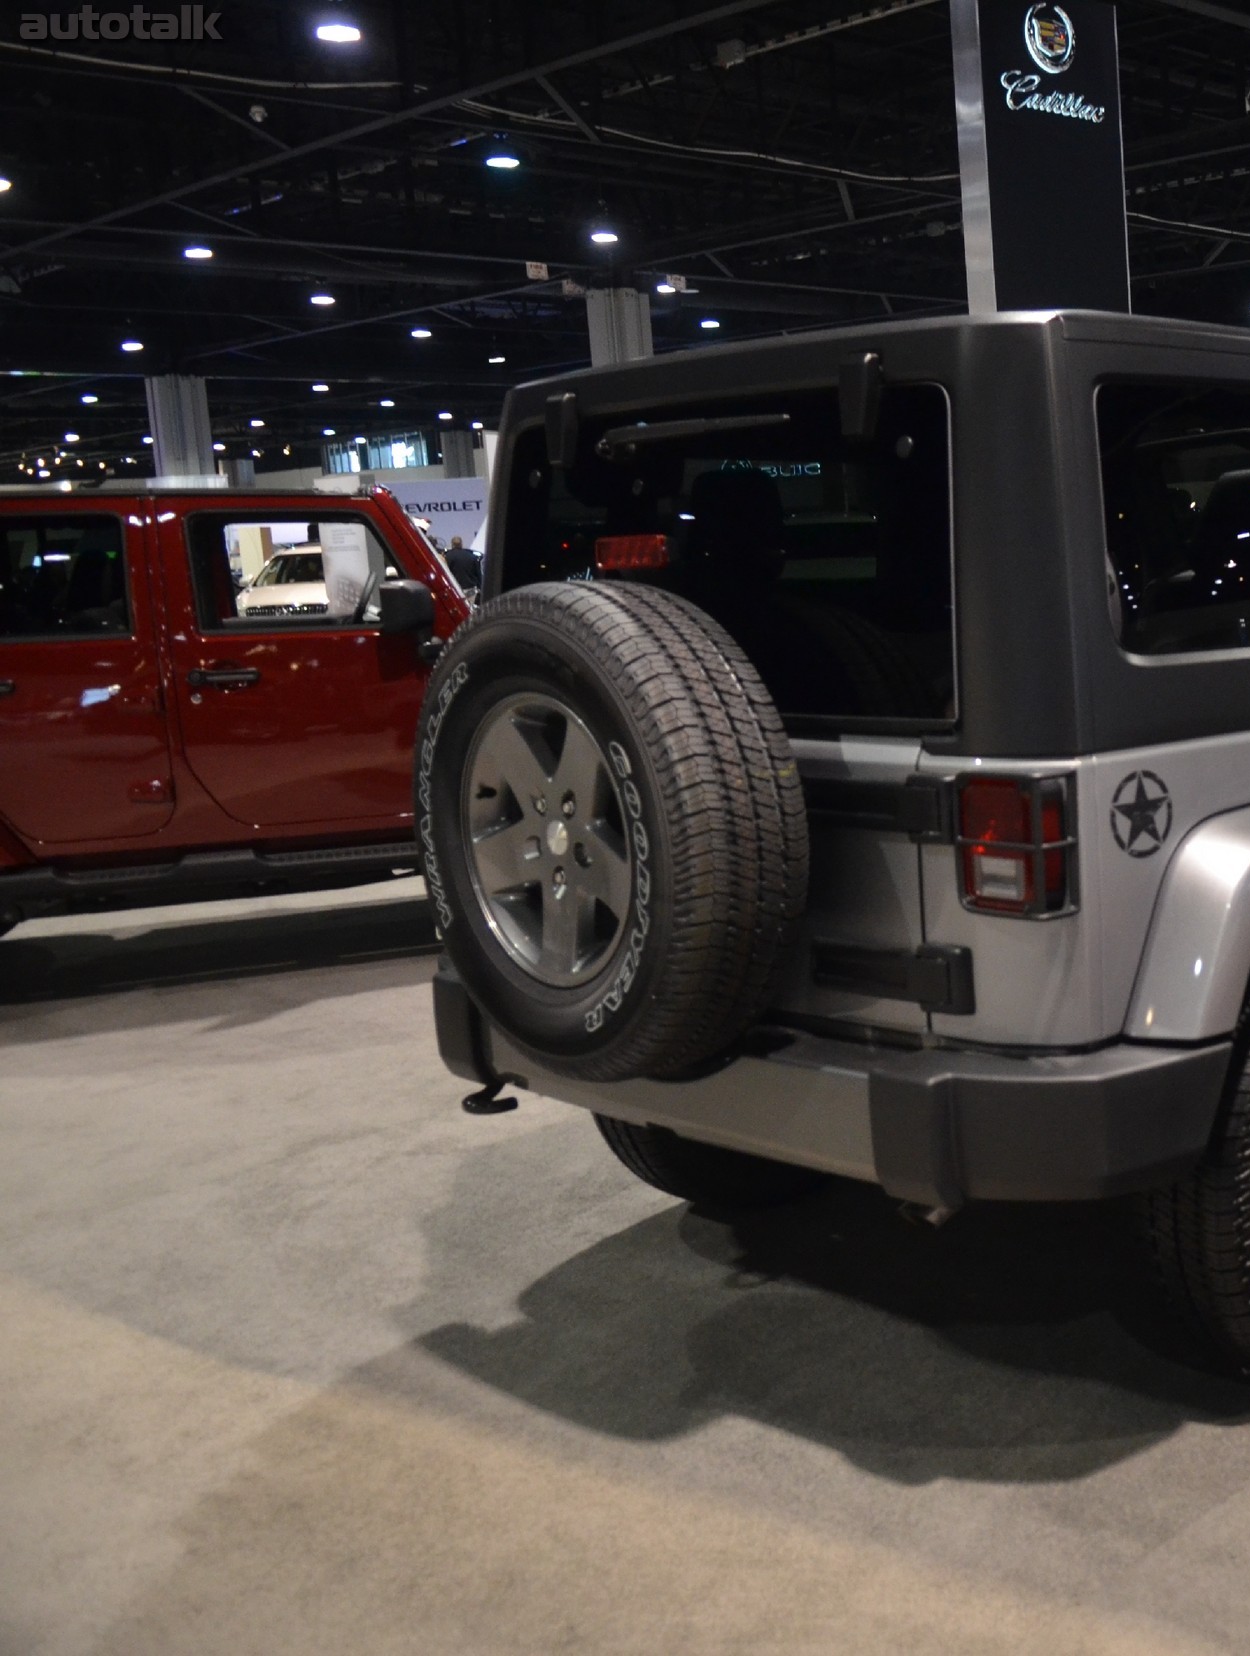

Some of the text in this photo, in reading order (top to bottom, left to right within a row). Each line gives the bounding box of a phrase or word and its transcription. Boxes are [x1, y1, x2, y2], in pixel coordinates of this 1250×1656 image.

[1000, 70, 1105, 123] Cadillac
[402, 499, 484, 514] EVROLET
[419, 661, 469, 929] WRANGLER
[584, 740, 650, 1033] GOODYEAR
